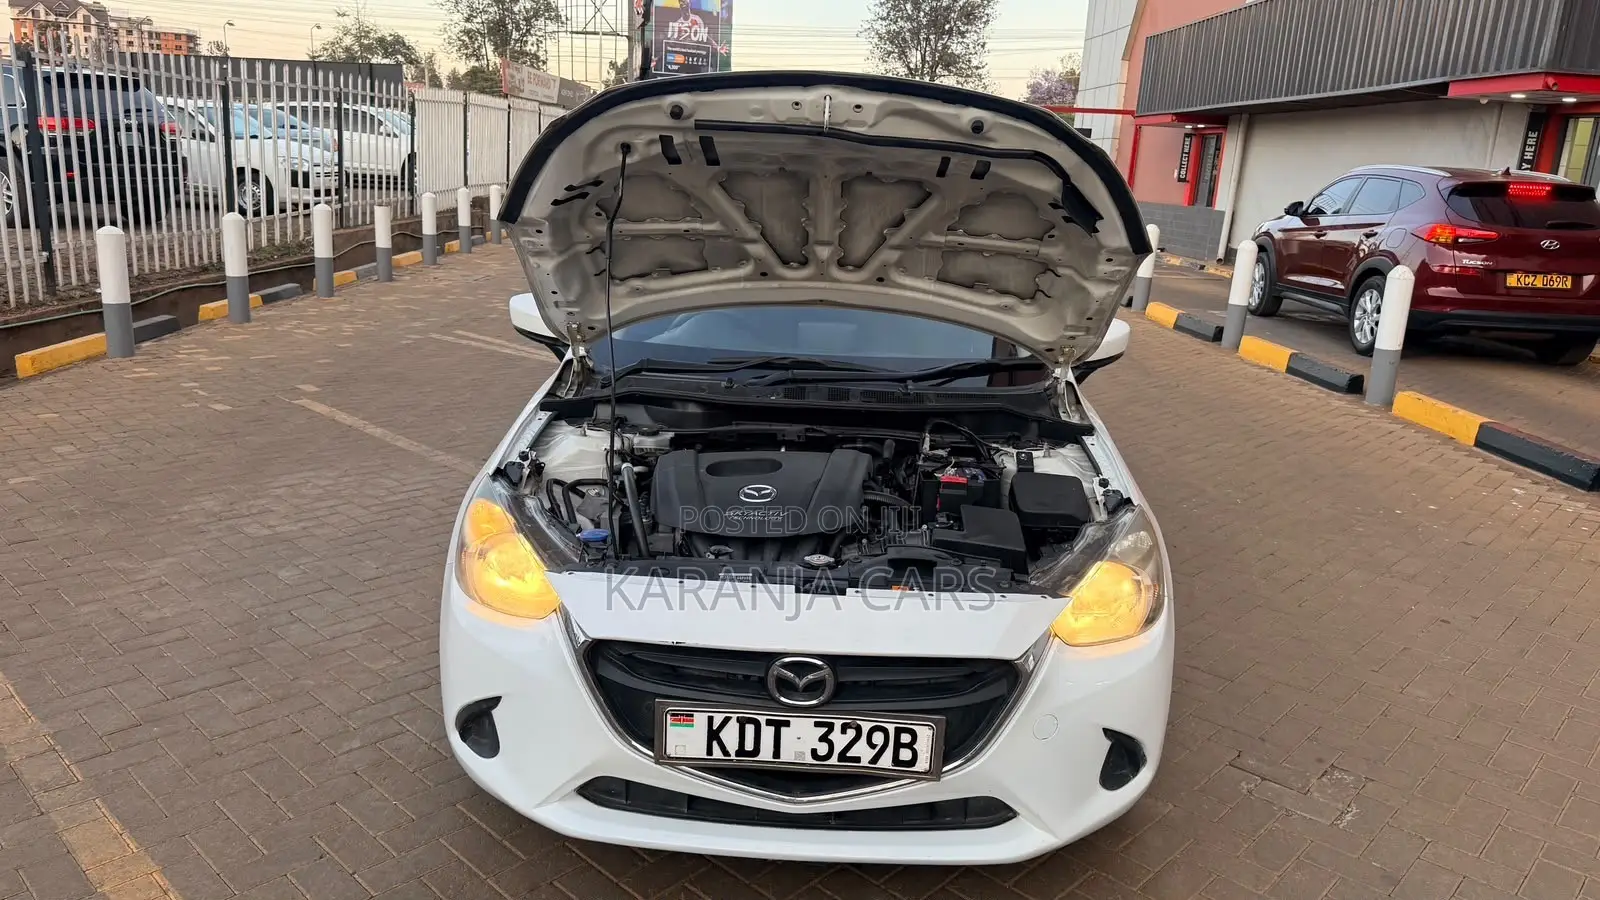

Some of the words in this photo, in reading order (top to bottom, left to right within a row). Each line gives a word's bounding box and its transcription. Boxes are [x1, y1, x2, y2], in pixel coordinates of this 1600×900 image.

[1524, 131, 1538, 160] HERE
[1180, 154, 1189, 179] COLLECT
[1516, 274, 1538, 287] KCZ
[1542, 275, 1569, 288] 069R
[705, 715, 791, 760] KDT
[810, 721, 918, 768] 329B
